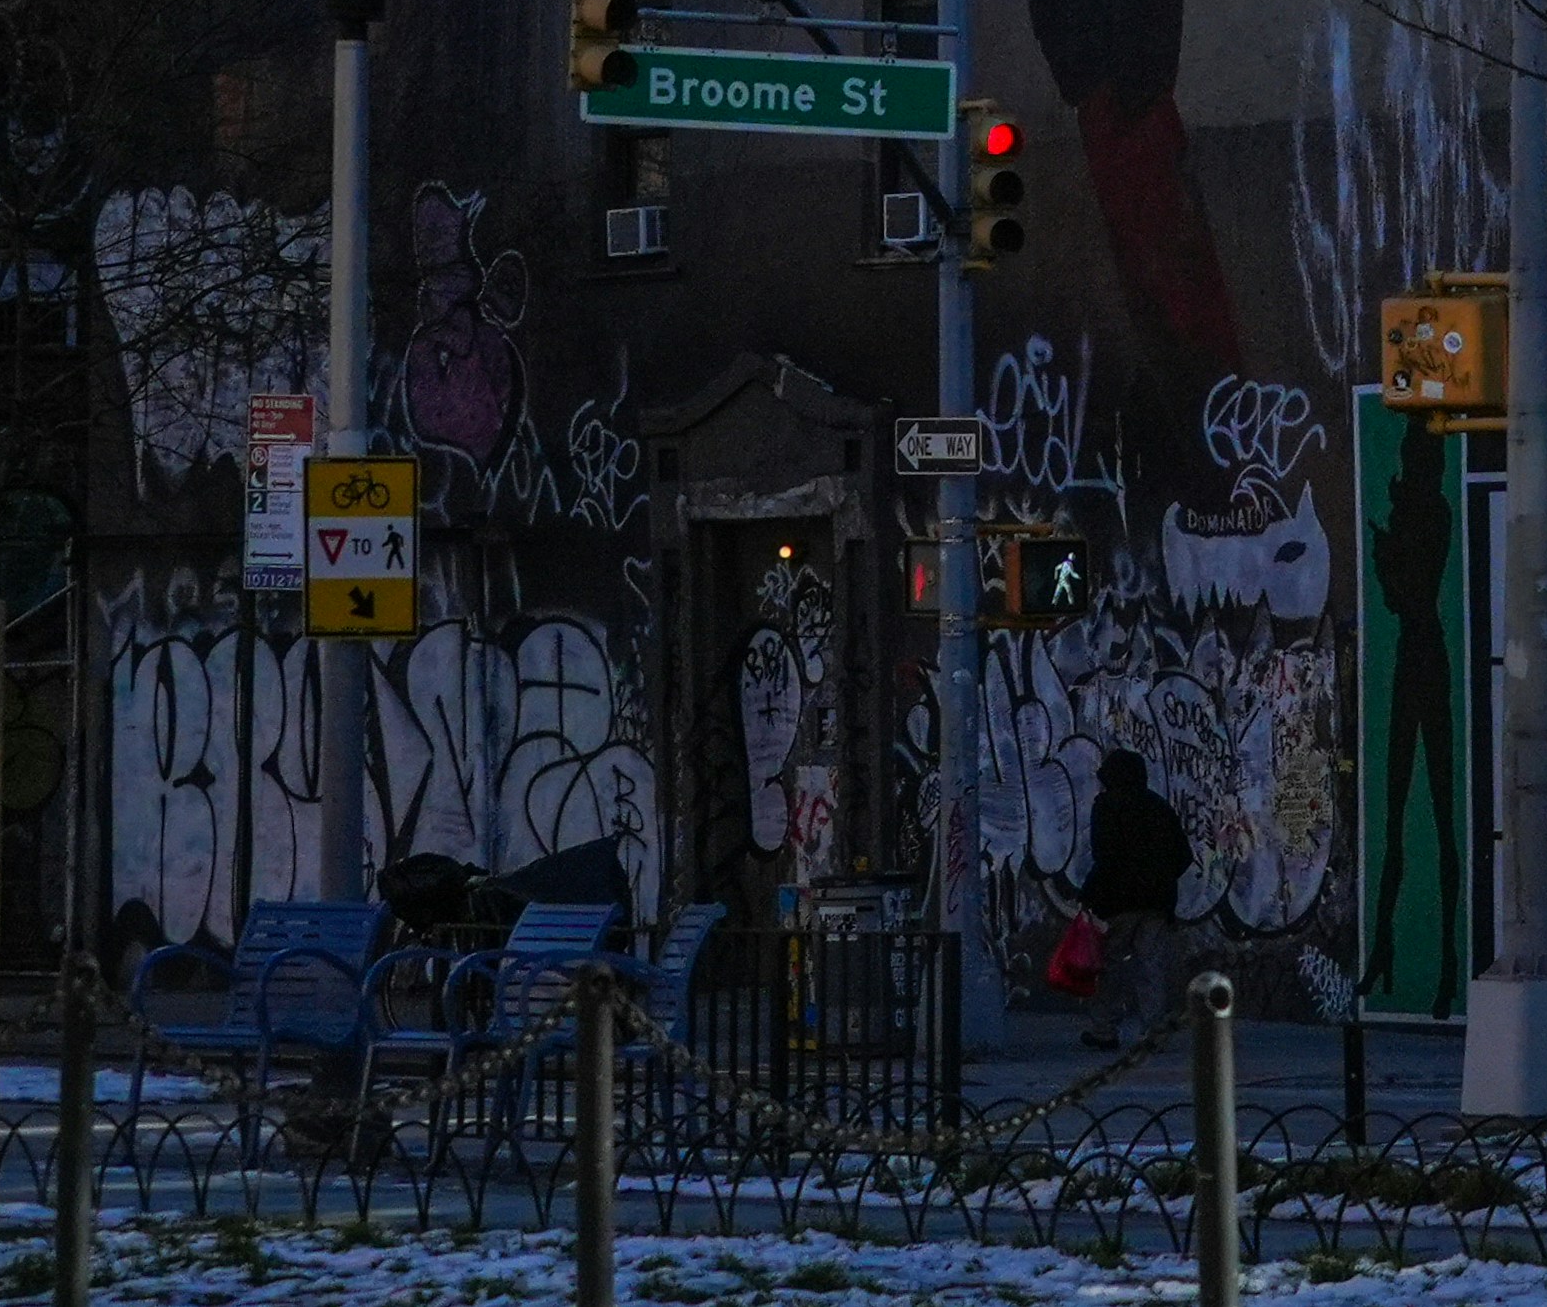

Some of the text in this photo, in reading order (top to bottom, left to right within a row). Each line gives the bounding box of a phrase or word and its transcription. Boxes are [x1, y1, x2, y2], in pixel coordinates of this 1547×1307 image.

[649, 67, 888, 116] Broome St
[907, 435, 973, 457] ONE WAY
[252, 492, 264, 512] 2
[1186, 496, 1277, 533] DOMINATOR
[352, 539, 372, 555] TO
